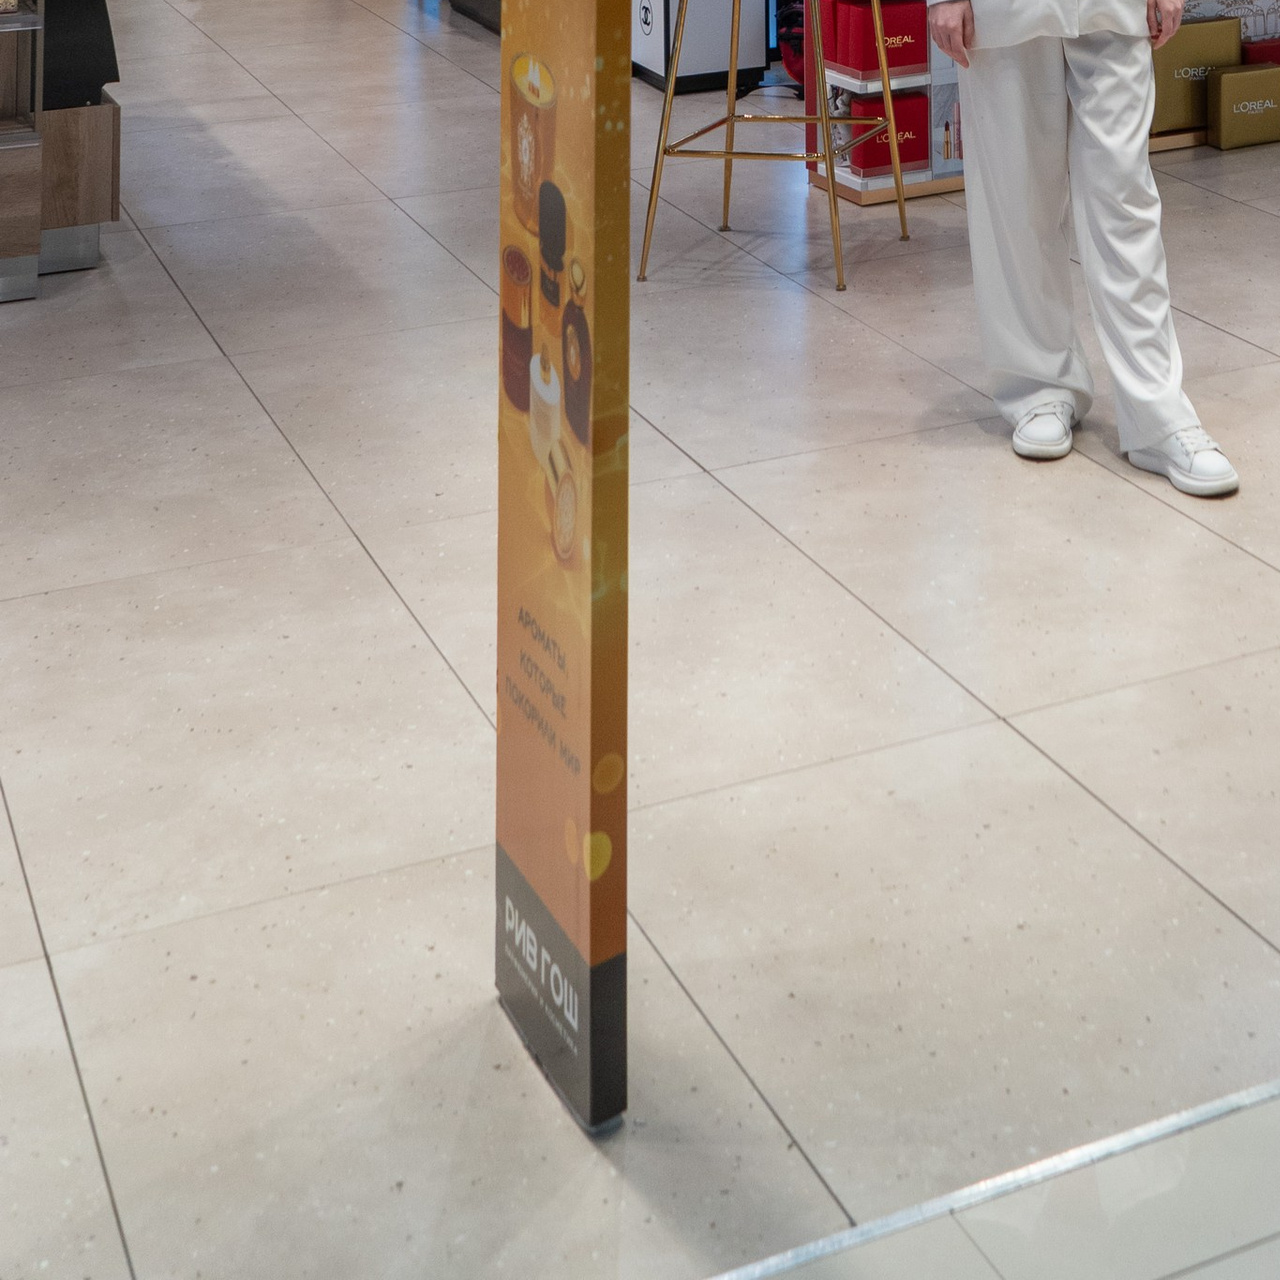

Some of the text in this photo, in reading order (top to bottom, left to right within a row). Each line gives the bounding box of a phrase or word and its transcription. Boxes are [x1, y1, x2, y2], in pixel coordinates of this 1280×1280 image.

[876, 34, 915, 47] ORÉAL
[876, 131, 916, 144] L'OÉAL
[519, 648, 567, 720] КОТОРЫЕ
[505, 674, 582, 777] ПОКОРИЛИ МИР
[505, 894, 579, 1032] РИВ ГОШ
